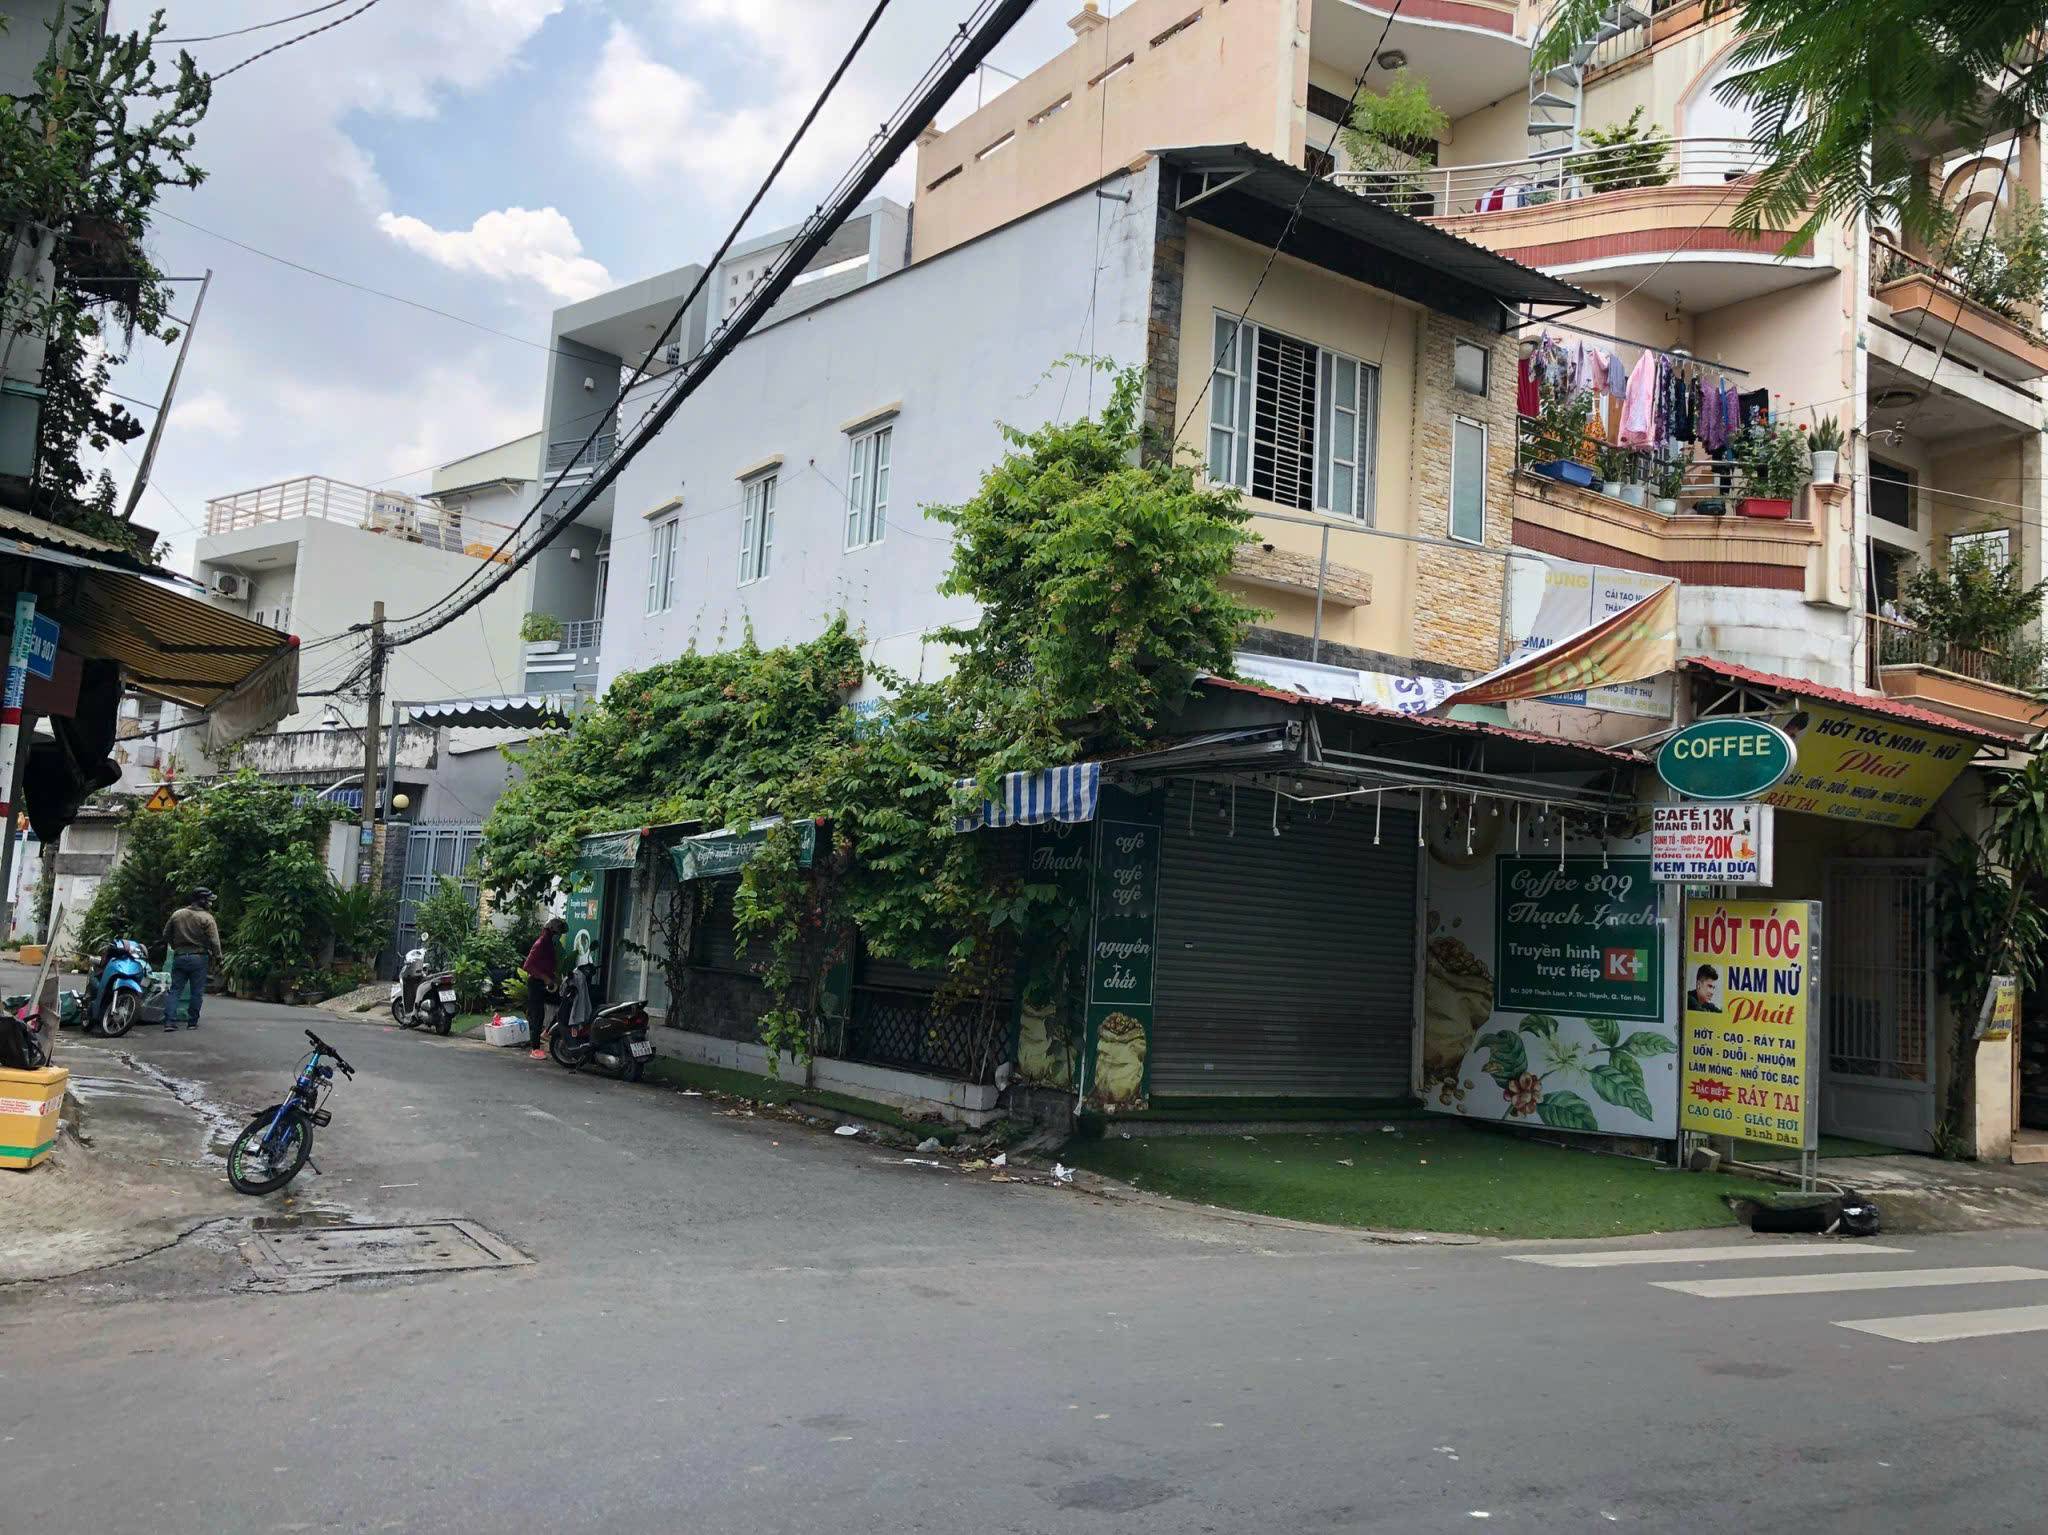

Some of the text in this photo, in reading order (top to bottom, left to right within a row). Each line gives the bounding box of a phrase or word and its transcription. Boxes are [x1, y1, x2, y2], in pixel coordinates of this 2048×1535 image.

[1673, 734, 1771, 760] COFFEE
[1816, 716, 1855, 737] HỚT
[1855, 725, 1888, 746] TÓC
[1888, 734, 1926, 755] NAM
[1834, 749, 1911, 779] Phát
[1796, 797, 1819, 811] TAI
[1654, 805, 1734, 831] CAFÉ 13K
[1654, 822, 1702, 831] MANG ĐI
[1704, 835, 1734, 859] 20K
[1654, 860, 1757, 873] KEM TRÁI DỪA
[1510, 869, 1633, 903] Coffee 309
[1507, 902, 1585, 930] Thạch
[1693, 906, 1800, 960] HỚT TÓC
[1508, 942, 1560, 961] Truyền
[1610, 953, 1644, 976] K+
[1537, 963, 1601, 982] trực tiếp
[1728, 963, 1802, 996] NAM NỮ
[1727, 997, 1795, 1025] Phát
[1693, 1027, 1796, 1050] HỚT CẠO RÁY TAI
[1692, 1043, 1796, 1067] UỐN DUỖI NHUỘM
[1688, 1060, 1800, 1088] LÀM MÓNG NHỔ TÓC BẠC
[1737, 1085, 1800, 1113] RÁY TAI
[1687, 1103, 1799, 1132] CẠO GIÓ GIÁC HƠI
